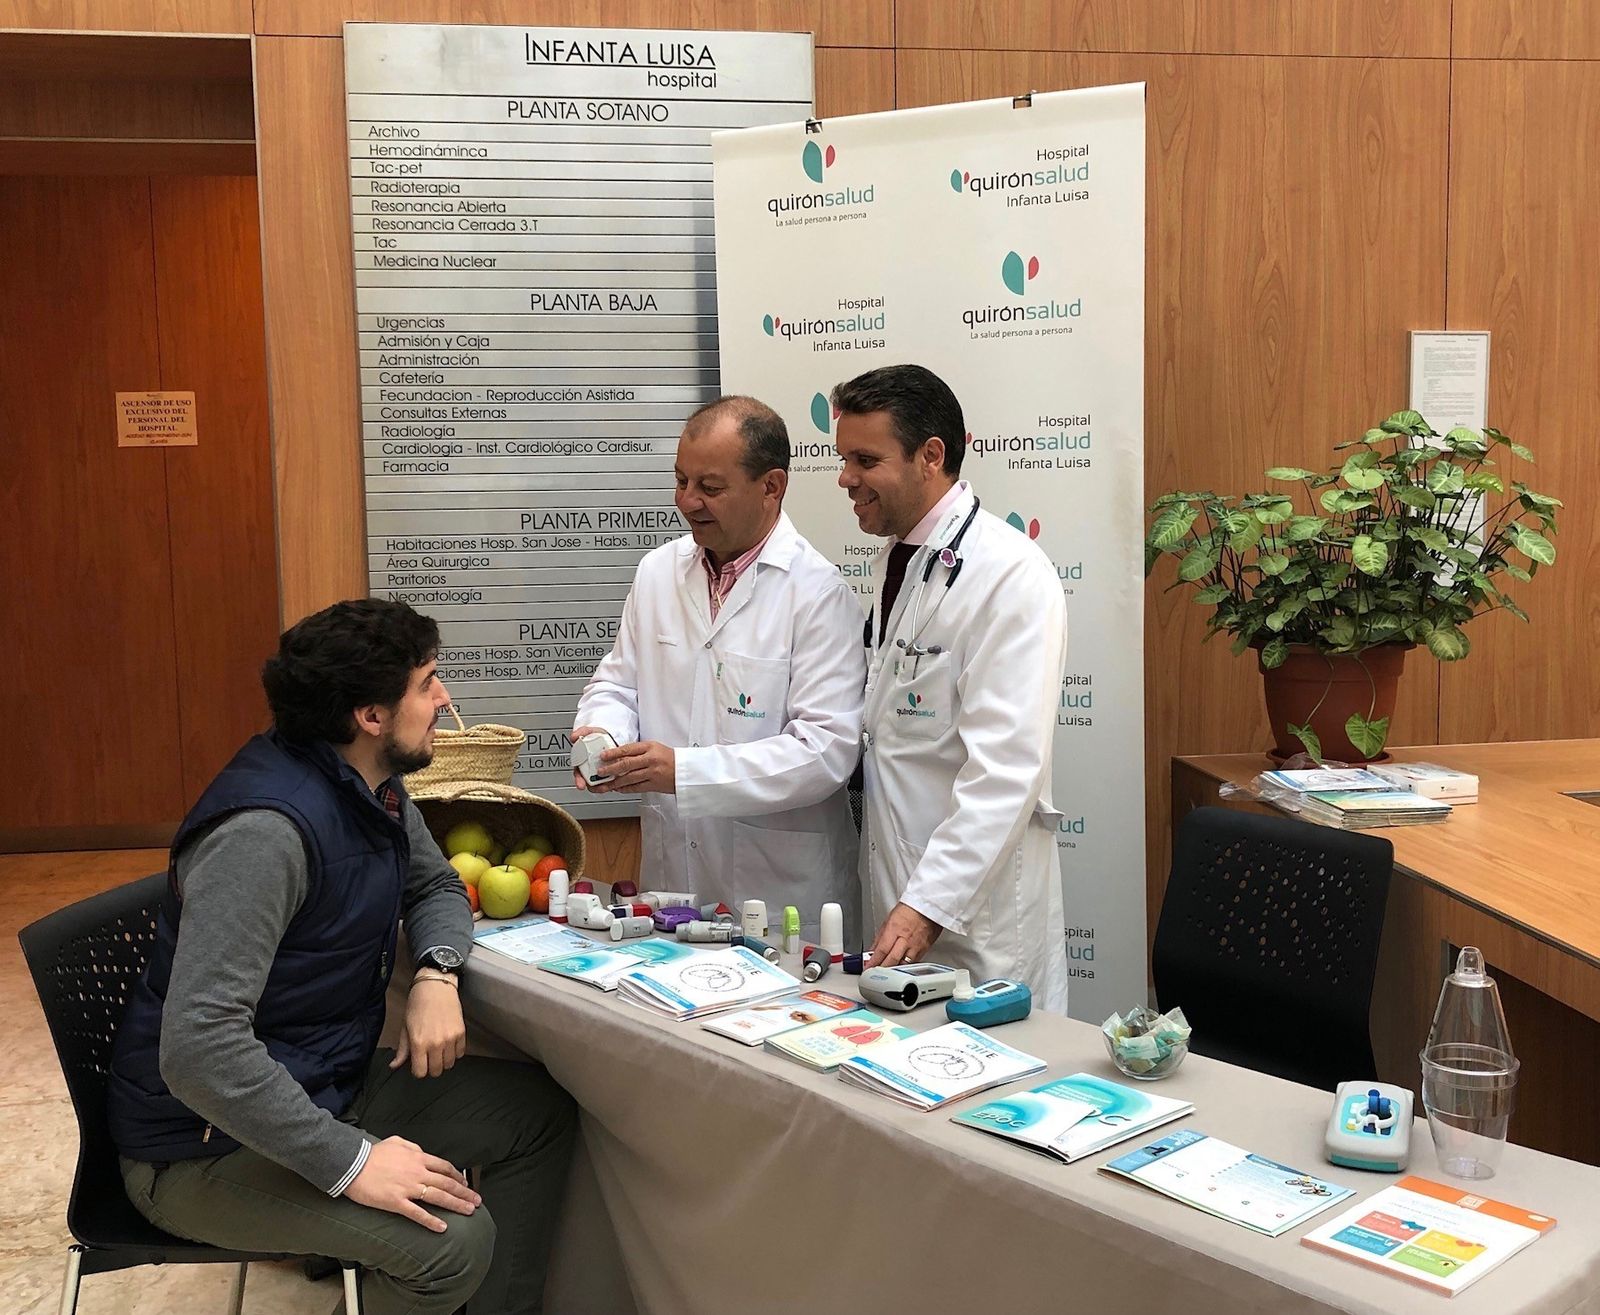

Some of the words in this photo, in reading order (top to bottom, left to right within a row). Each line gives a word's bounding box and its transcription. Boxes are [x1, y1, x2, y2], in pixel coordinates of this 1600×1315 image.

[647, 43, 716, 66] LUISA
[648, 71, 717, 91] hospital
[508, 101, 581, 121] PLANTA
[586, 102, 669, 122] SOTANO
[368, 124, 420, 138] Archivo
[369, 143, 488, 158] Hemodináminca
[1037, 144, 1089, 161] Hospital
[370, 161, 423, 176] Tac-pet
[970, 162, 1089, 197] quirónsalud
[371, 181, 460, 196] Radioterapia
[768, 184, 874, 217] quirónsalud
[1007, 194, 1051, 207] Infanta
[1055, 190, 1089, 203] Luisa
[371, 200, 455, 214] Resonancia
[457, 200, 506, 214] Abierta
[372, 218, 455, 232] Resonancia
[458, 218, 517, 232] Cerrada
[785, 217, 802, 226] salud
[804, 216, 831, 225] persona
[839, 212, 867, 222] persona
[373, 237, 397, 249] Tac
[373, 254, 439, 268] Medicina
[443, 254, 497, 268] Nuclear
[531, 294, 603, 312] PLANTA
[609, 294, 658, 312] BAJA
[838, 296, 884, 311] Hospital
[963, 298, 1081, 329] quirónsalud
[376, 316, 445, 331] Urgencias
[781, 312, 884, 341] quirónsalud
[980, 330, 1000, 338] salud
[1002, 329, 1033, 339] persona
[1041, 326, 1073, 337] persona
[378, 334, 441, 348] Admisión
[444, 337, 453, 351] y
[456, 334, 490, 349] Caja
[813, 340, 851, 352] Infanta
[854, 337, 885, 349] Luisa
[379, 352, 480, 367] Administración
[379, 371, 444, 385] Cafetería
[380, 388, 472, 402] Fecundacion
[486, 388, 582, 403] Reproducción
[585, 388, 635, 401] Asistida
[380, 406, 448, 419] Consultas
[451, 406, 507, 419] Externas
[1039, 414, 1091, 428] Hospital
[381, 424, 455, 439] Radiología
[382, 442, 462, 457] Cardiología
[476, 441, 500, 454] Inst.
[505, 441, 593, 456] Cardiológico
[597, 440, 653, 454] Cardisur.
[972, 431, 1091, 458] quirónsalud
[382, 459, 449, 472] Farmacia
[1008, 458, 1052, 469] Infanta
[1056, 457, 1091, 468] Luisa
[521, 513, 592, 530] PLANTA
[598, 511, 681, 528] PRIMERA
[386, 538, 476, 551] Habitaciones
[480, 537, 517, 550] Hosp.
[522, 537, 547, 548] San
[550, 537, 581, 548] Jose
[594, 535, 630, 546] Habs.
[637, 534, 657, 545] 101
[386, 554, 418, 568] Área
[421, 556, 490, 570] Quirurgica
[387, 573, 447, 586] Paritorios
[388, 589, 482, 604] Neonatología
[519, 622, 590, 640] PLANTA
[484, 648, 521, 661] Hosp.
[526, 646, 550, 658] San
[554, 645, 605, 658] Vicente
[484, 666, 521, 678] Hosp.
[1058, 714, 1093, 726] Luisa
[529, 758, 544, 769] La
